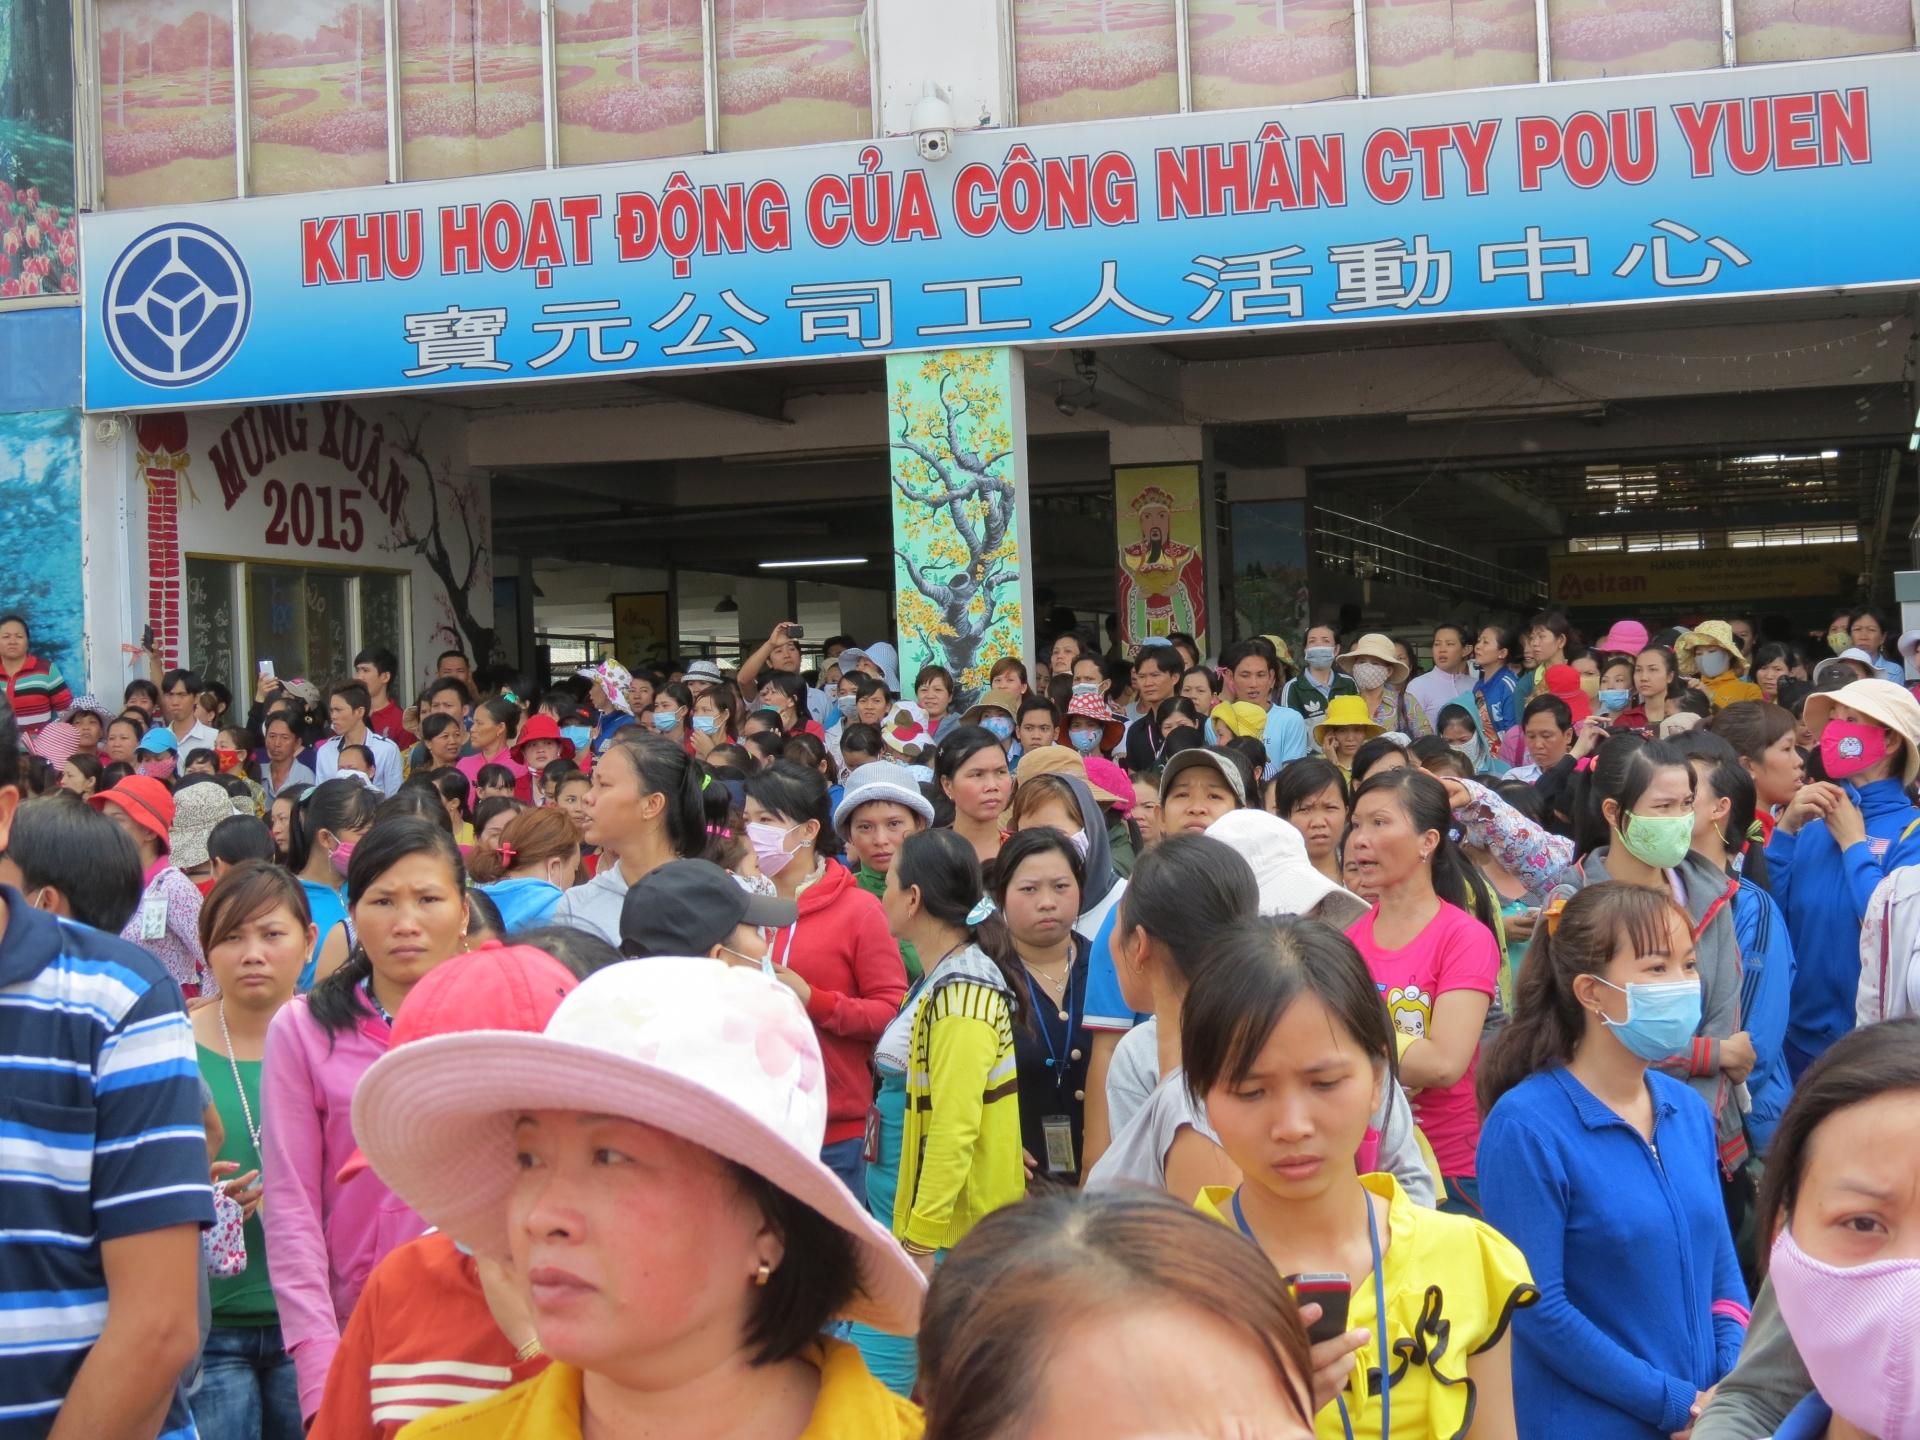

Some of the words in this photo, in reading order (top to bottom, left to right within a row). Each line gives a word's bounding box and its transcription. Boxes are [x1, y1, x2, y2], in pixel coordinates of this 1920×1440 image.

[302, 209, 424, 287] KHU
[439, 195, 602, 288] HOẠT
[615, 171, 791, 278] ĐỘNG
[806, 147, 941, 248] CỦA
[953, 144, 1139, 238] CÔNG
[1156, 121, 1347, 221] NHÂN
[1363, 119, 1502, 205] CTY
[1517, 106, 1658, 192] POU
[1674, 87, 1872, 178] YUEN
[403, 219, 1752, 377] 寶元公司工人活動中心
[263, 479, 364, 553] 2015
[318, 400, 410, 528] XUÂN
[1557, 572, 1648, 601] Meizan
